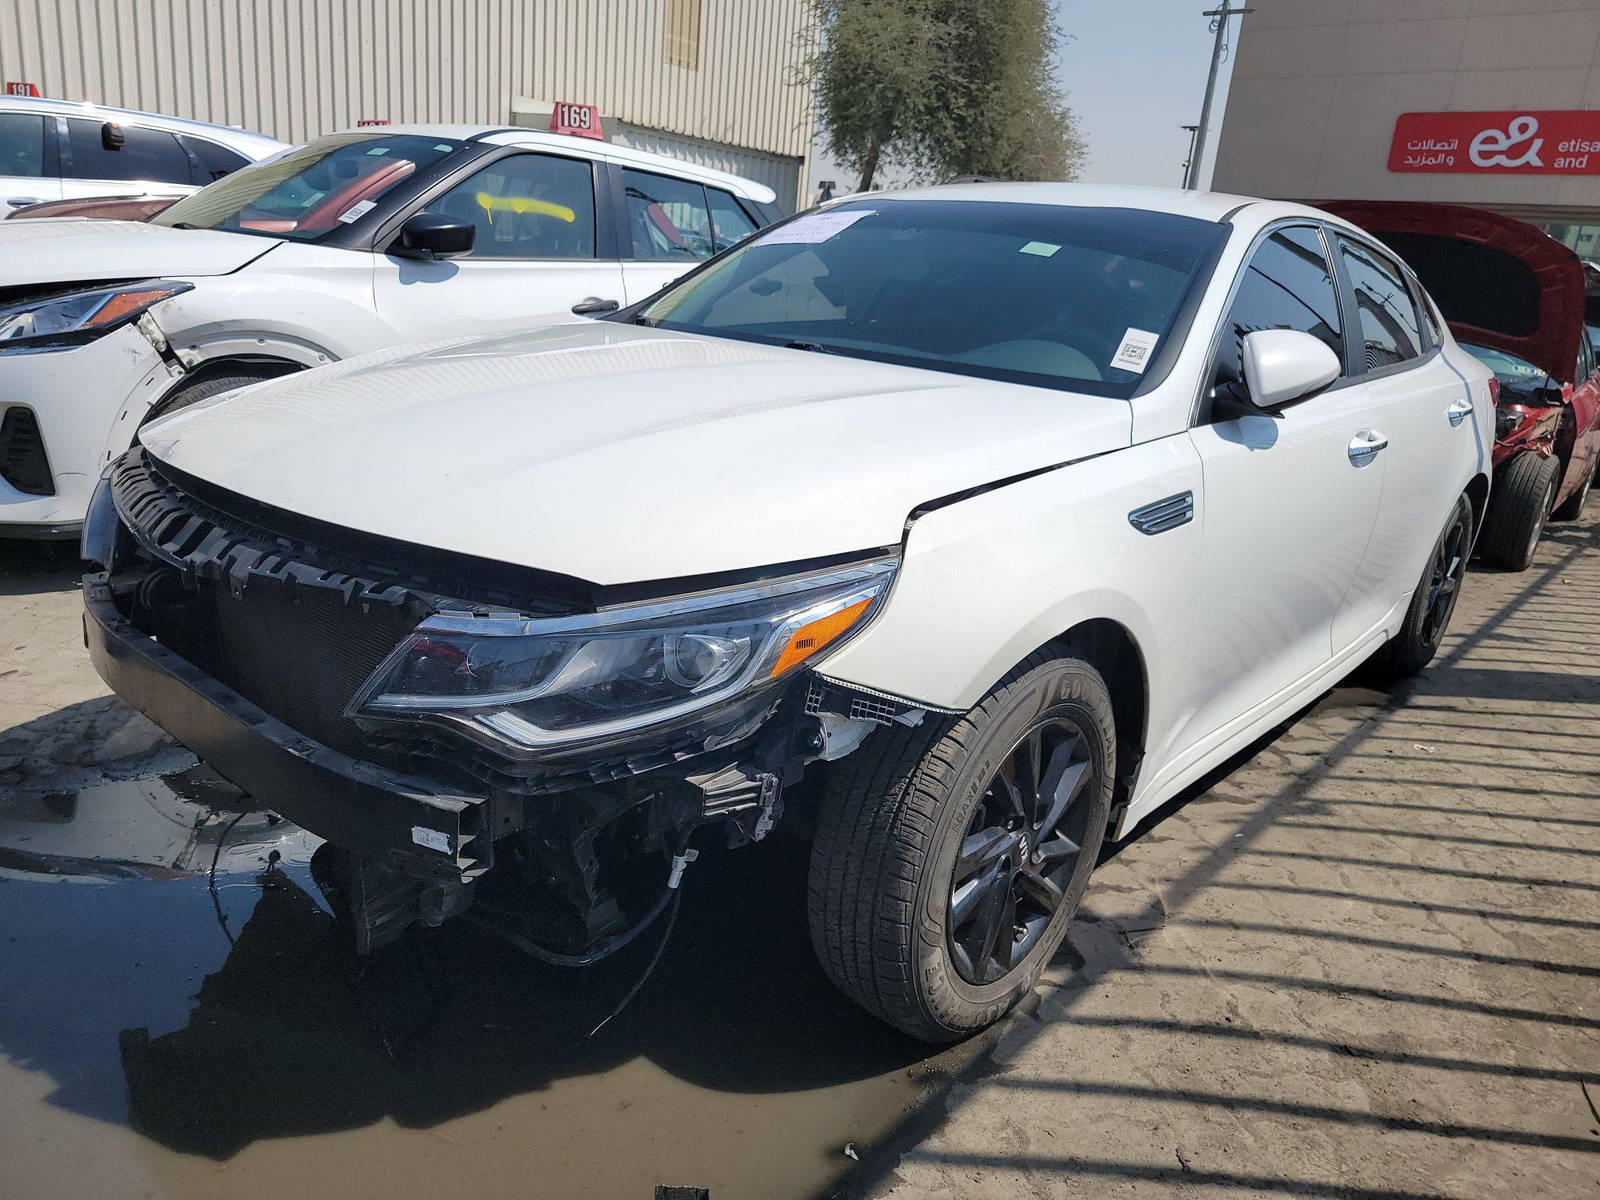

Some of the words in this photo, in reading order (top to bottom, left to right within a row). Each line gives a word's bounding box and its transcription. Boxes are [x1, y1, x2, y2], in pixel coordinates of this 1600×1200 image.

[12, 83, 31, 96] 191
[562, 104, 591, 129] 169
[1407, 138, 1459, 151] اتصالات
[1558, 138, 1600, 153] etisa
[1553, 154, 1588, 169] and
